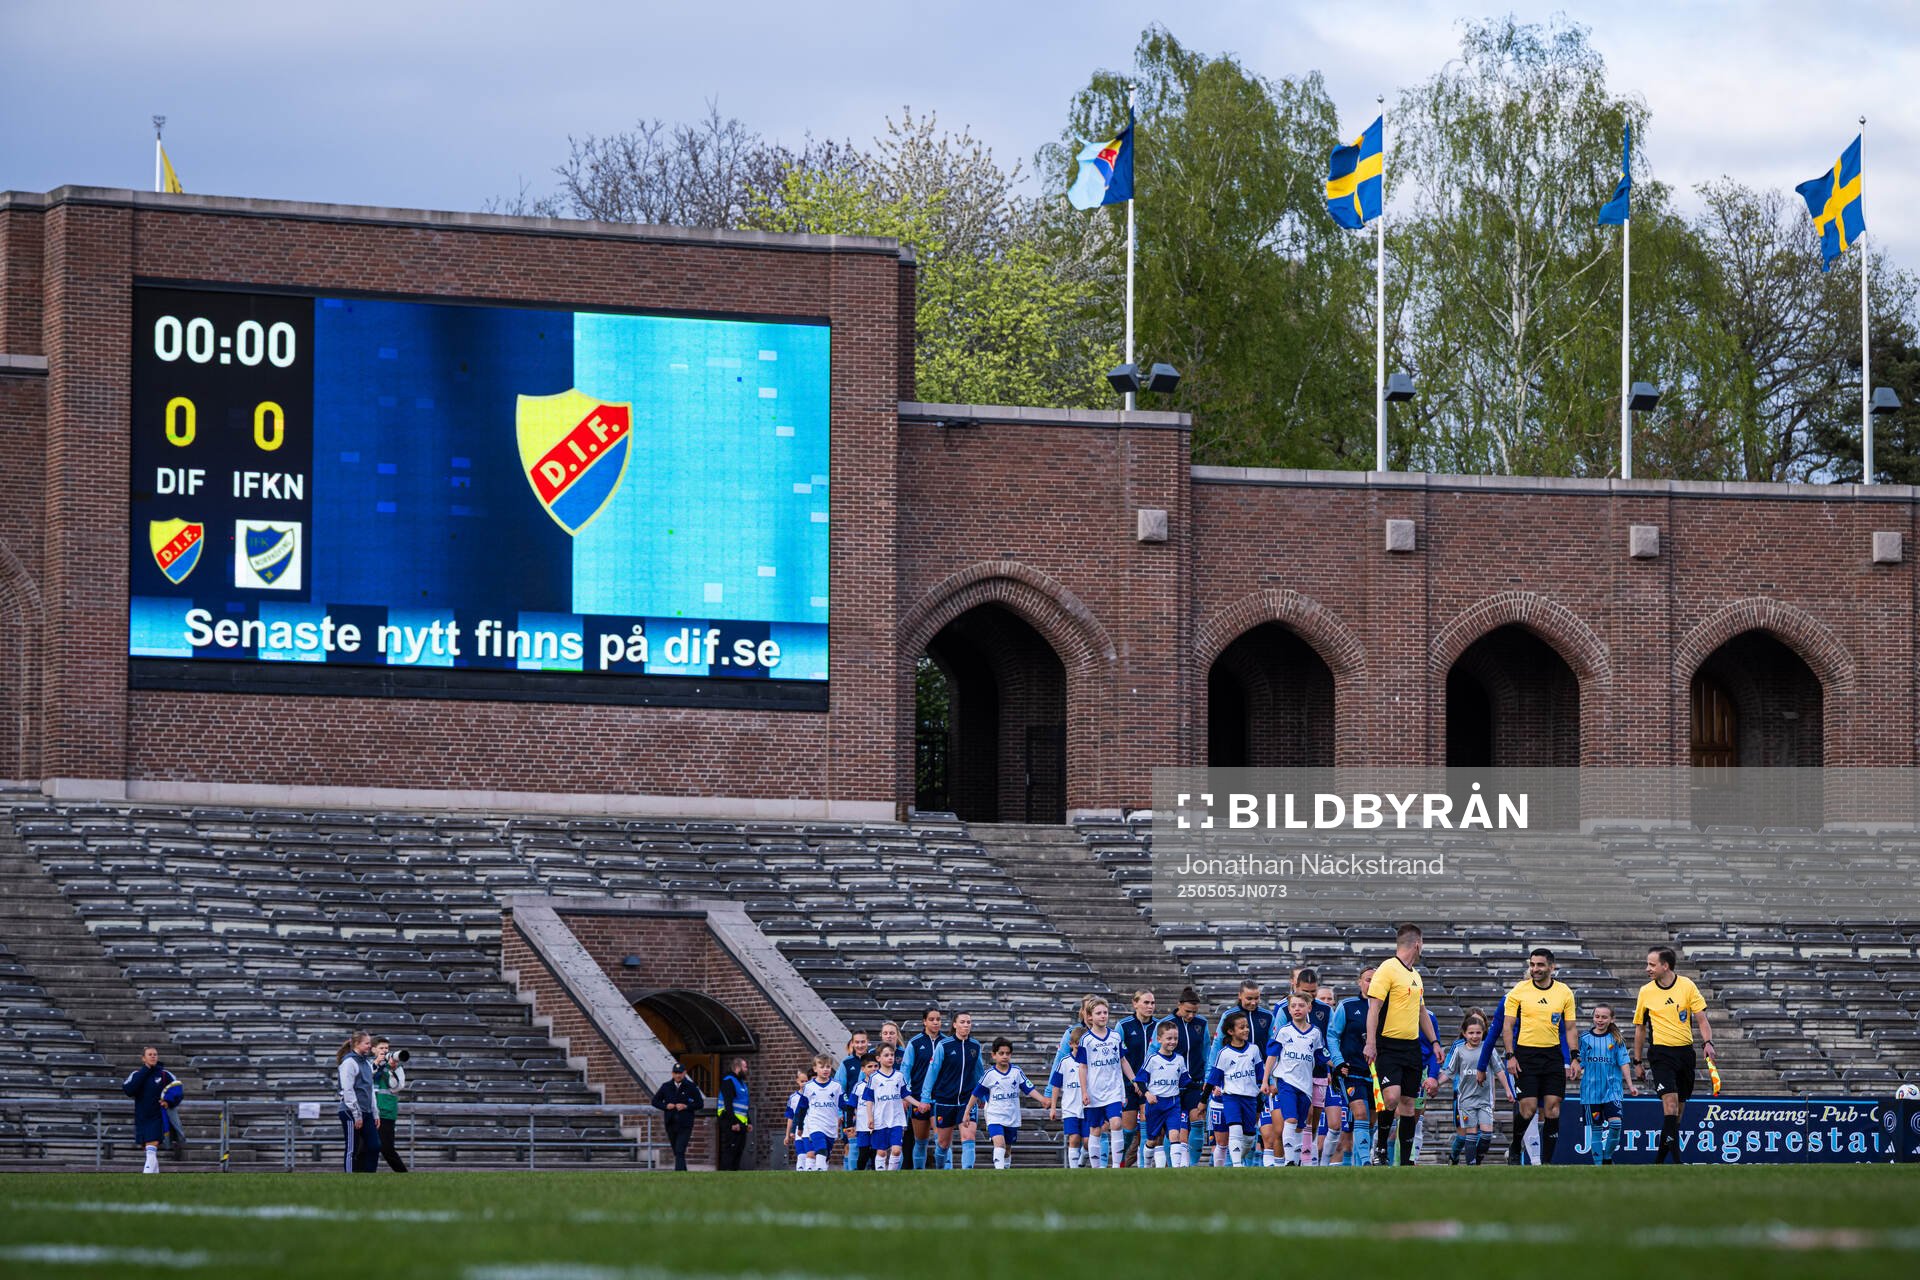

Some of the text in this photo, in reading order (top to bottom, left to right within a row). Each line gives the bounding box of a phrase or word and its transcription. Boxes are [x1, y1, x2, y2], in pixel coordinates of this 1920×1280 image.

[154, 315, 296, 368] 00:00
[165, 396, 284, 451] 0 0
[539, 415, 620, 488] D.I.F.
[156, 467, 304, 500] DIF IFKN
[160, 530, 199, 562] D.I.F.
[183, 607, 781, 670] Senaste nytt finns på dif.se
[1284, 1051, 1313, 1063] HOLME
[1067, 1081, 1081, 1089] HOL
[1230, 1068, 1255, 1080] HOLME
